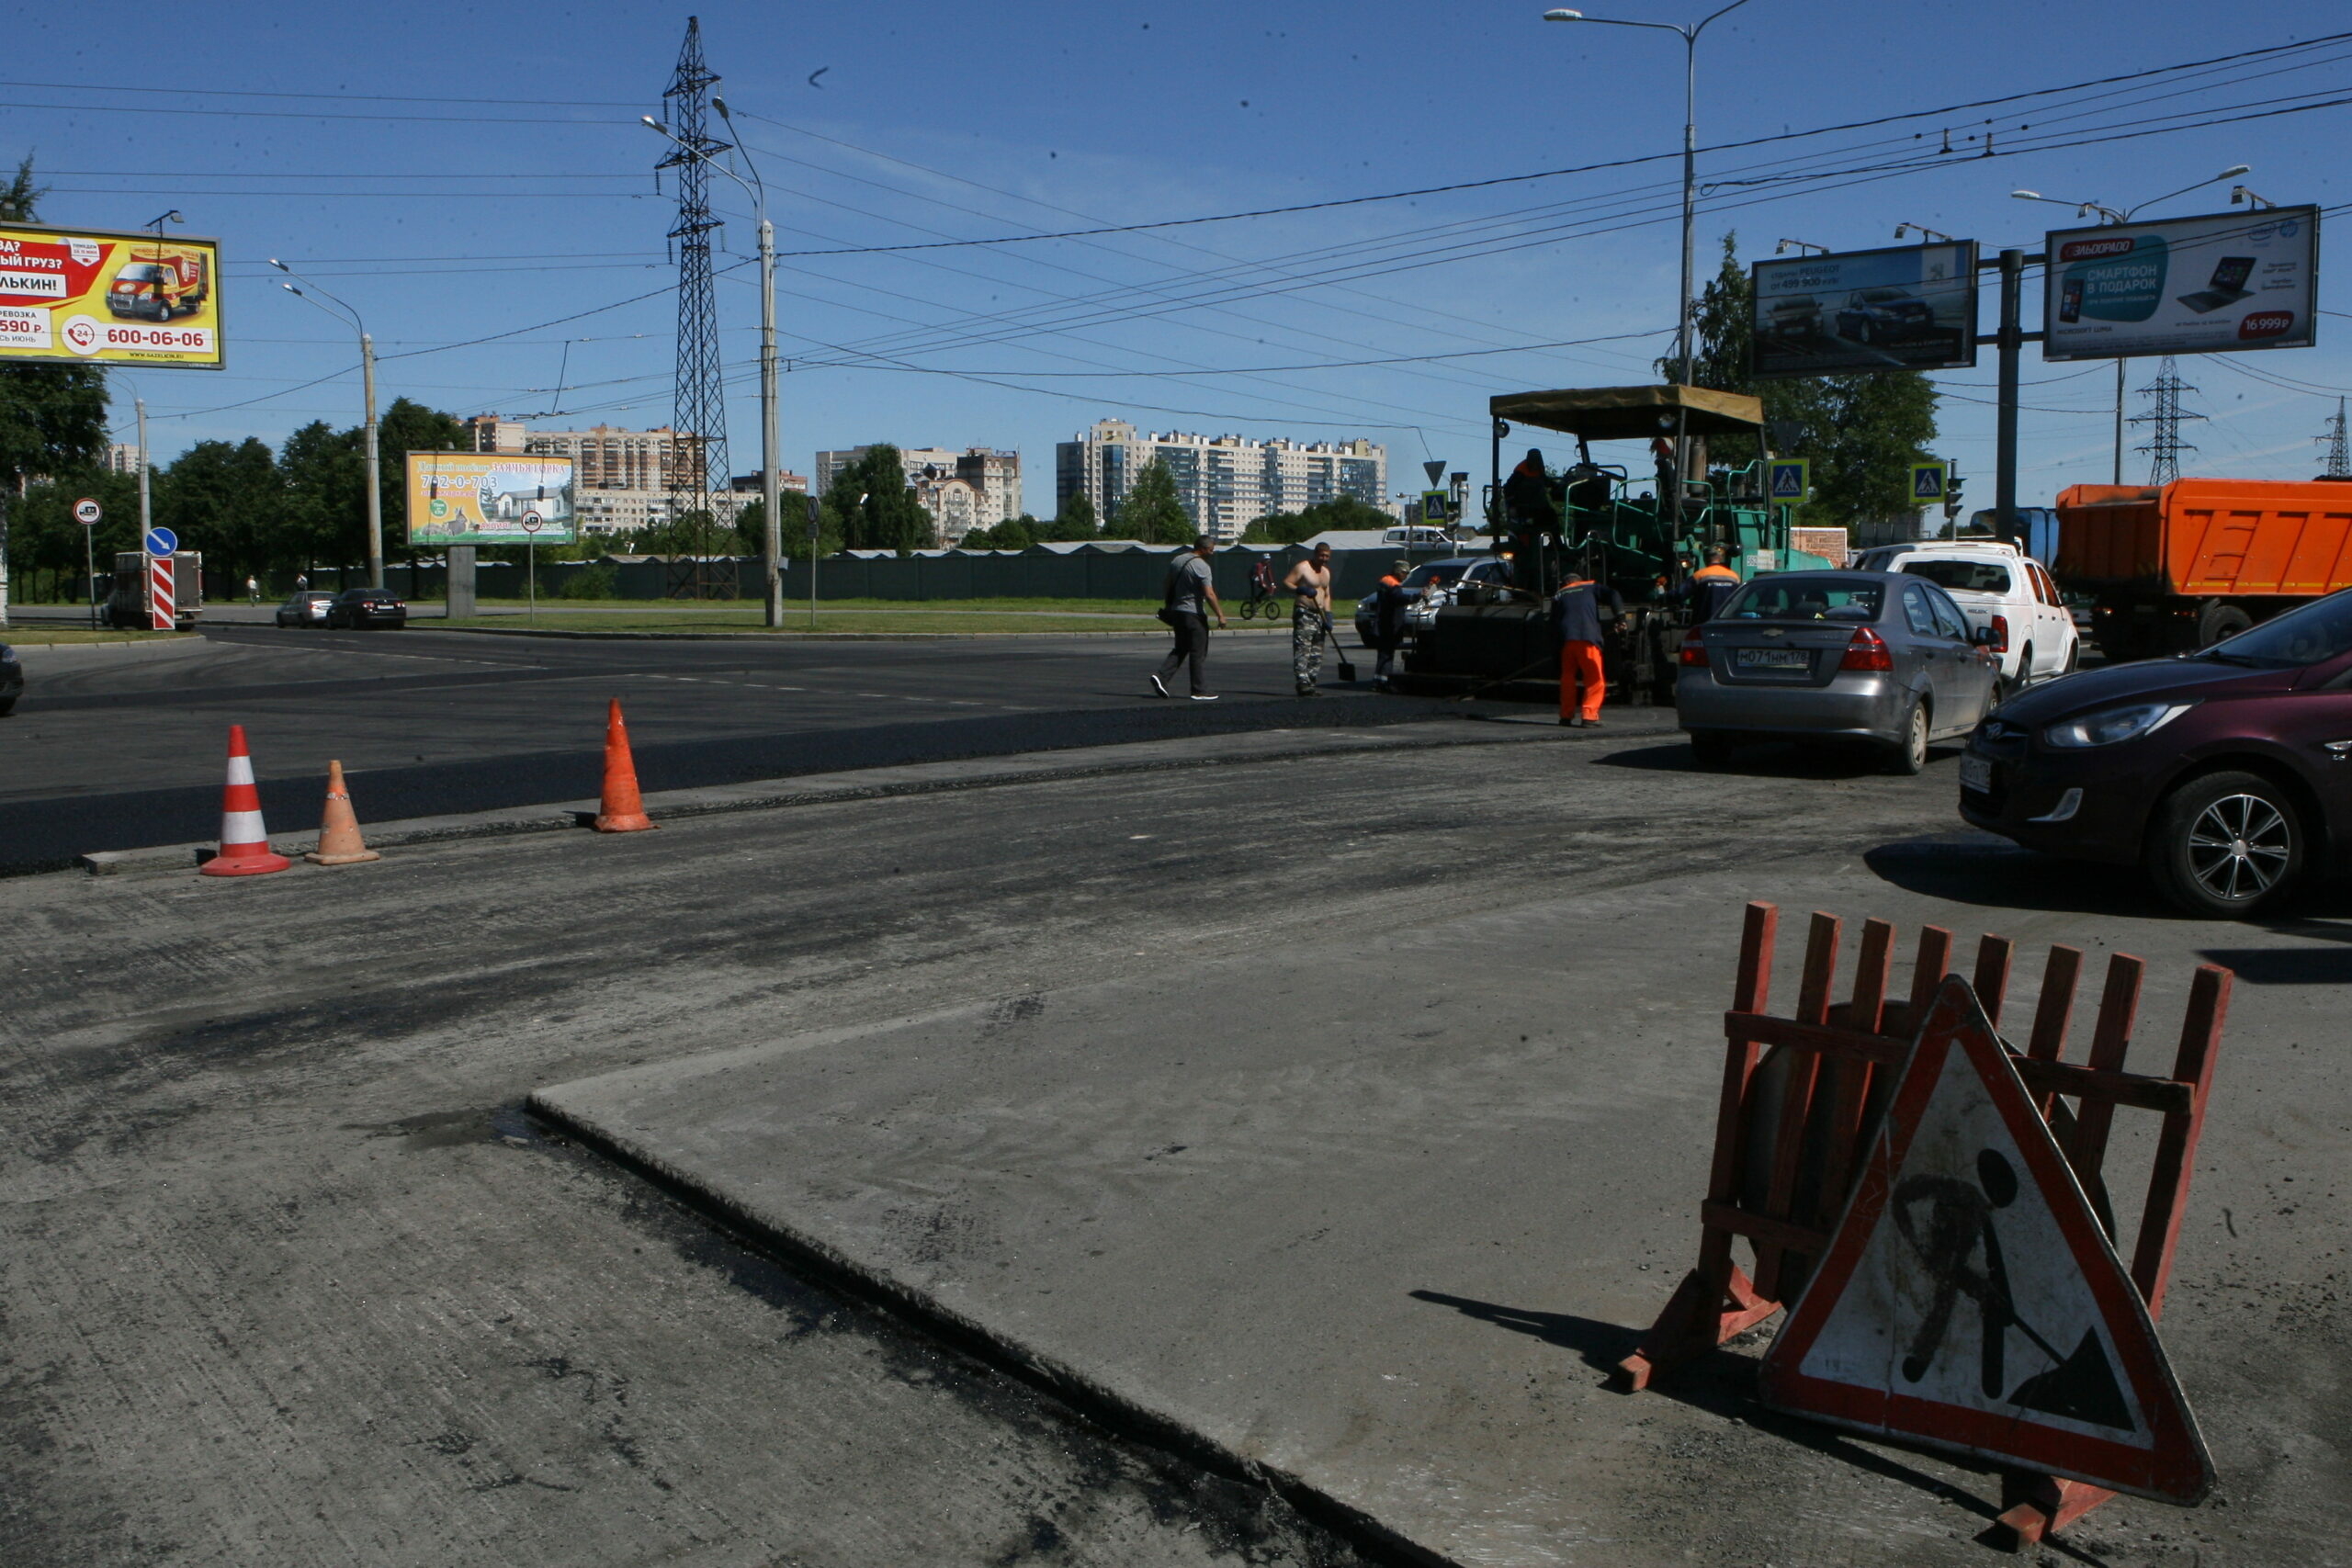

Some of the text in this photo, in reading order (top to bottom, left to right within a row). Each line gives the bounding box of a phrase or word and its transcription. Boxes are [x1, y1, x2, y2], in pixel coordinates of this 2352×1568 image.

[2073, 241, 2131, 257] ЭЛЬДОРАДО
[25, 256, 62, 269] ГРУЗ?
[1800, 265, 1840, 276] PEUGEOT
[2087, 265, 2157, 281] СМАРТФОН
[2087, 278, 2156, 294] В ПОДАРОК
[2245, 320, 2257, 331] 16
[2258, 318, 2281, 331] 999
[12, 335, 37, 344] ИЮНЬ
[107, 329, 203, 346] 600-06-06
[1739, 649, 1807, 663] М071НМ 178
